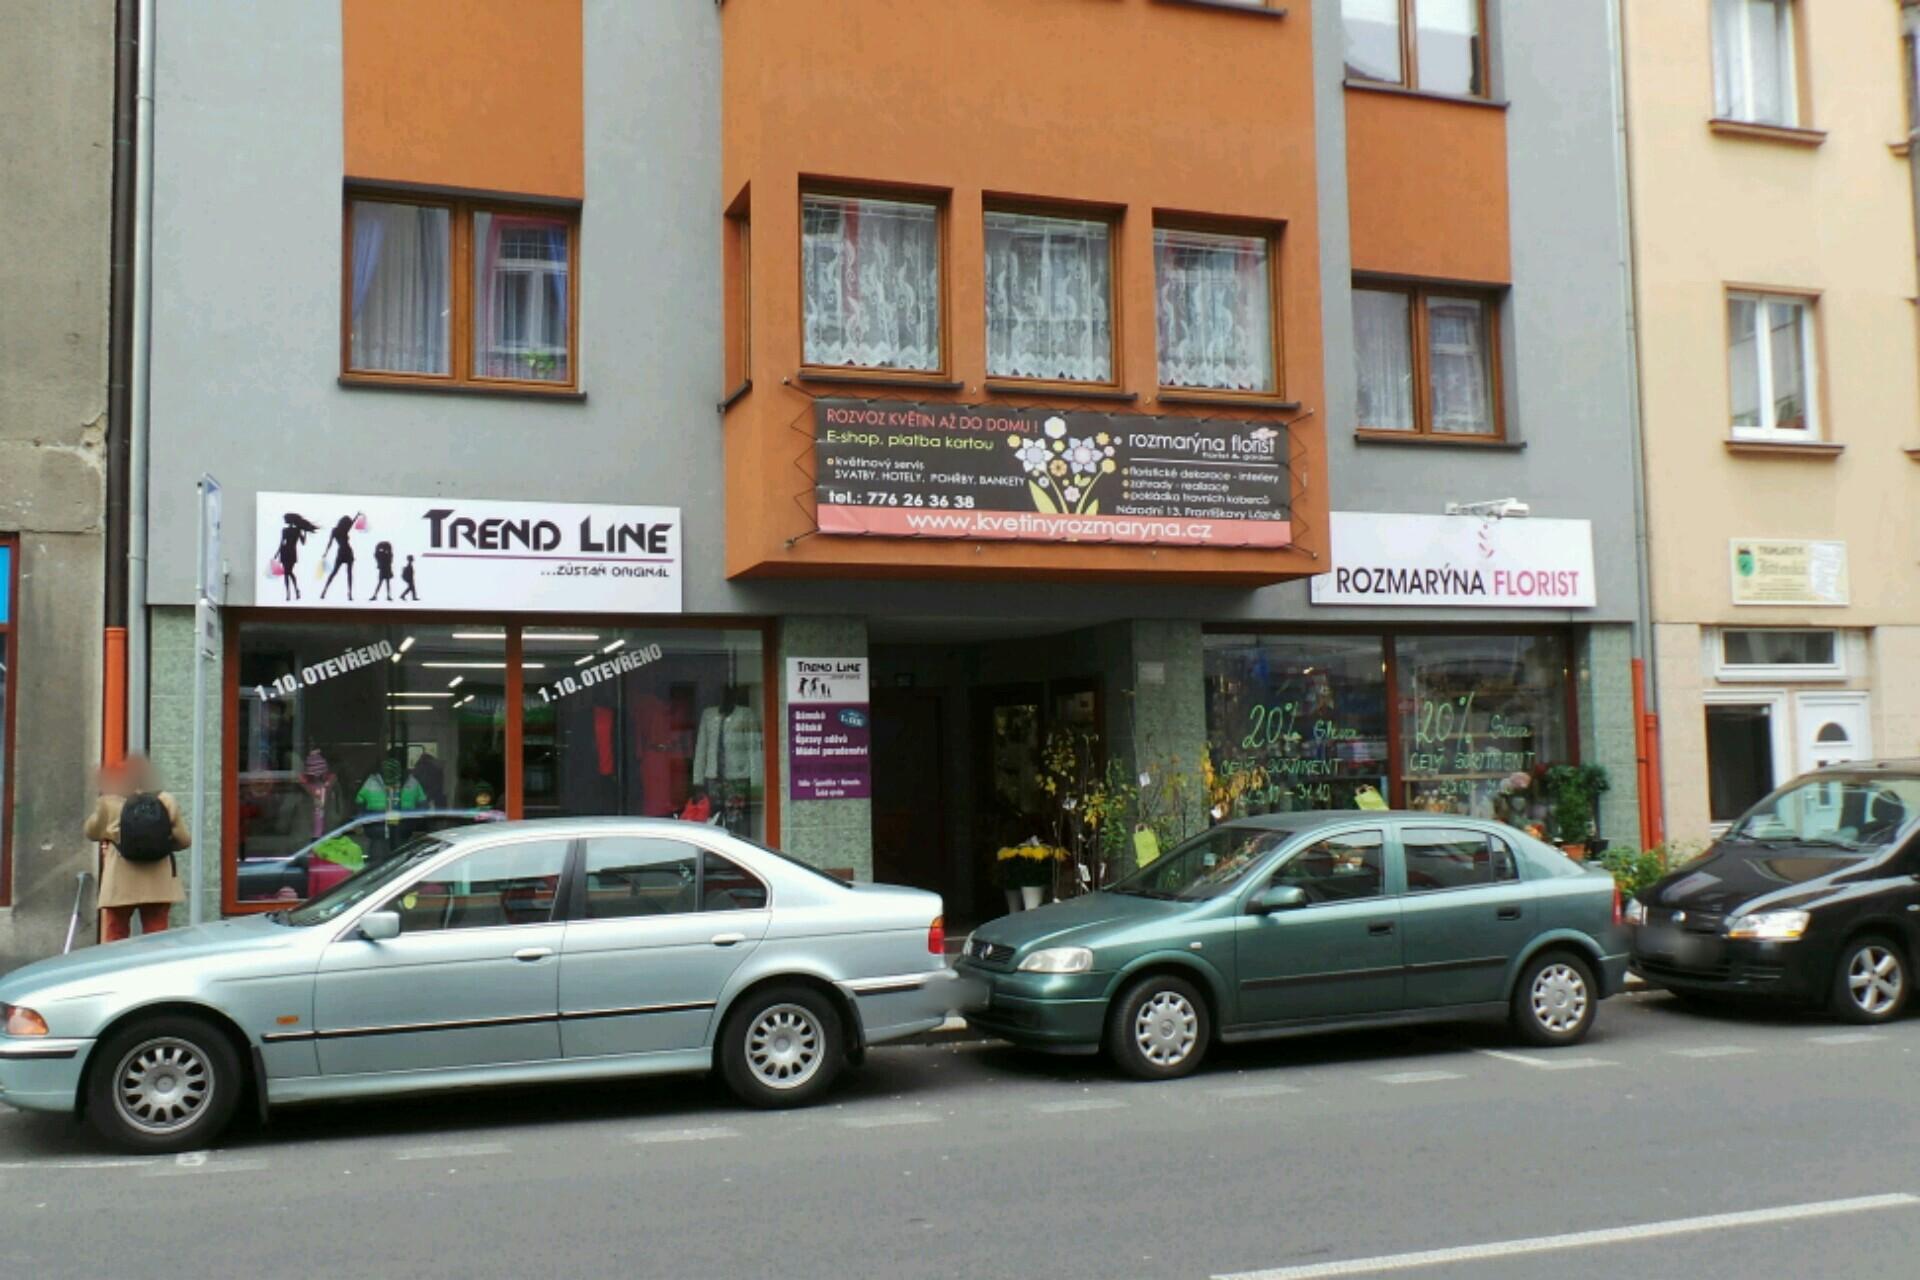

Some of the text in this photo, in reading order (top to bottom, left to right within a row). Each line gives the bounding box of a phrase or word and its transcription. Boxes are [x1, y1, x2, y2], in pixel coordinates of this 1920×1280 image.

[827, 408, 886, 425] ROZVOZ
[888, 410, 935, 427] KVĚTIN
[939, 413, 957, 429] AŽ
[960, 416, 982, 430] DO
[987, 418, 1030, 432] DOMU
[888, 433, 941, 448] platba
[945, 436, 994, 450] kartou
[1129, 432, 1225, 454] rozmarýna
[835, 457, 891, 470] květinový
[979, 475, 1025, 487] BANKETY
[1180, 469, 1231, 480] dekorace
[1130, 479, 1173, 491] zahrady
[1181, 481, 1229, 492] realizace
[829, 490, 975, 508] tel.: 776 26 36 38
[1116, 504, 1164, 516] Národní
[421, 509, 561, 551] TREND
[906, 512, 1213, 538] www.kvetinyrozmaryna.cz
[1336, 562, 1579, 598] ROZMARÝNA FLORIST
